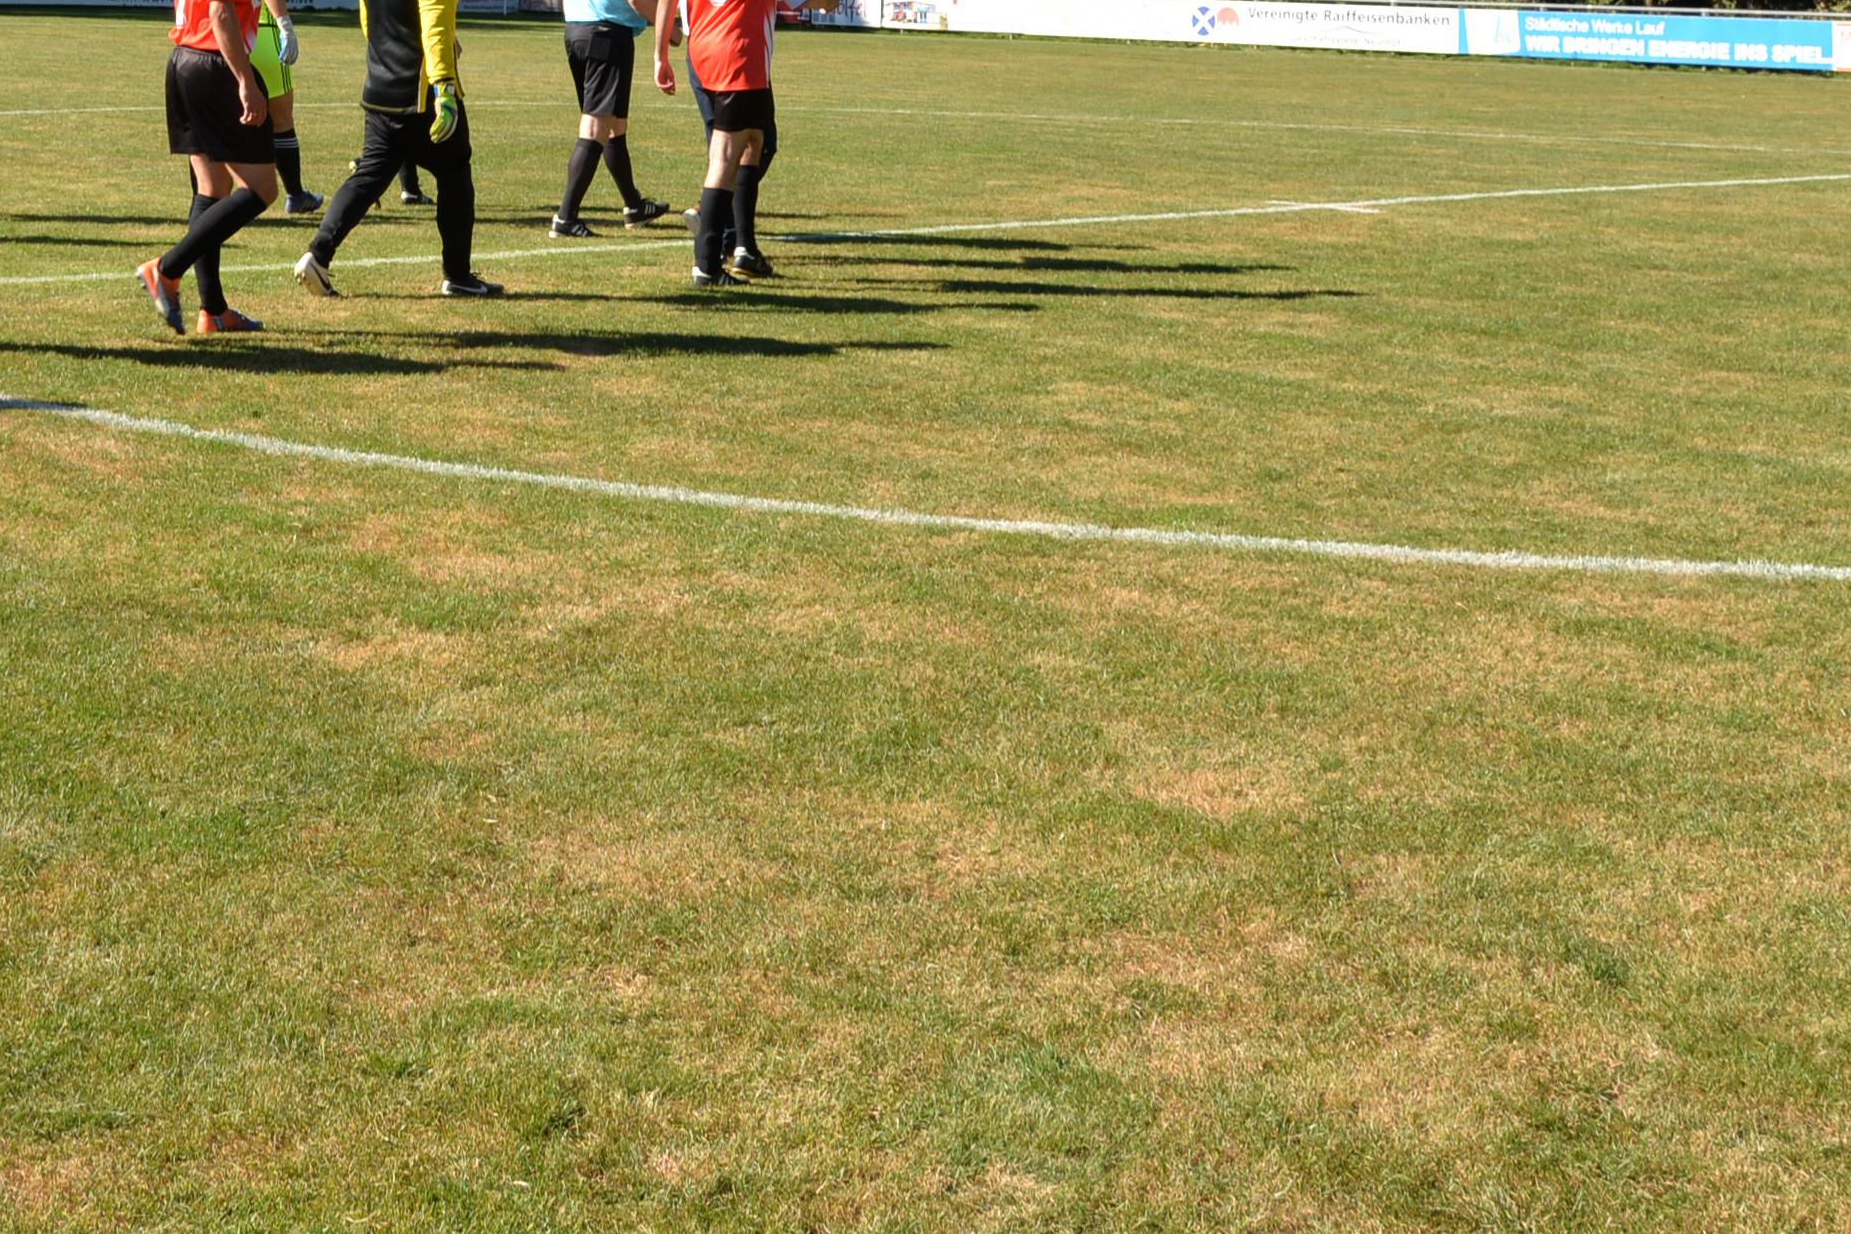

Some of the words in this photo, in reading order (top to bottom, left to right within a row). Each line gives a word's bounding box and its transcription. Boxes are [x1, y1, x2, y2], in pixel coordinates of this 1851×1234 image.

[1248, 7, 1317, 24] Vereinigte
[1324, 10, 1450, 26] Raiffeisenbanken
[1525, 16, 1589, 34] Städtische
[1591, 18, 1633, 35] Werke
[1635, 20, 1665, 36] Lauf
[1524, 35, 1560, 53] WIR
[1562, 36, 1645, 56] BRINGEN
[1648, 39, 1731, 60] ENERGIE
[1734, 42, 1768, 62] INS
